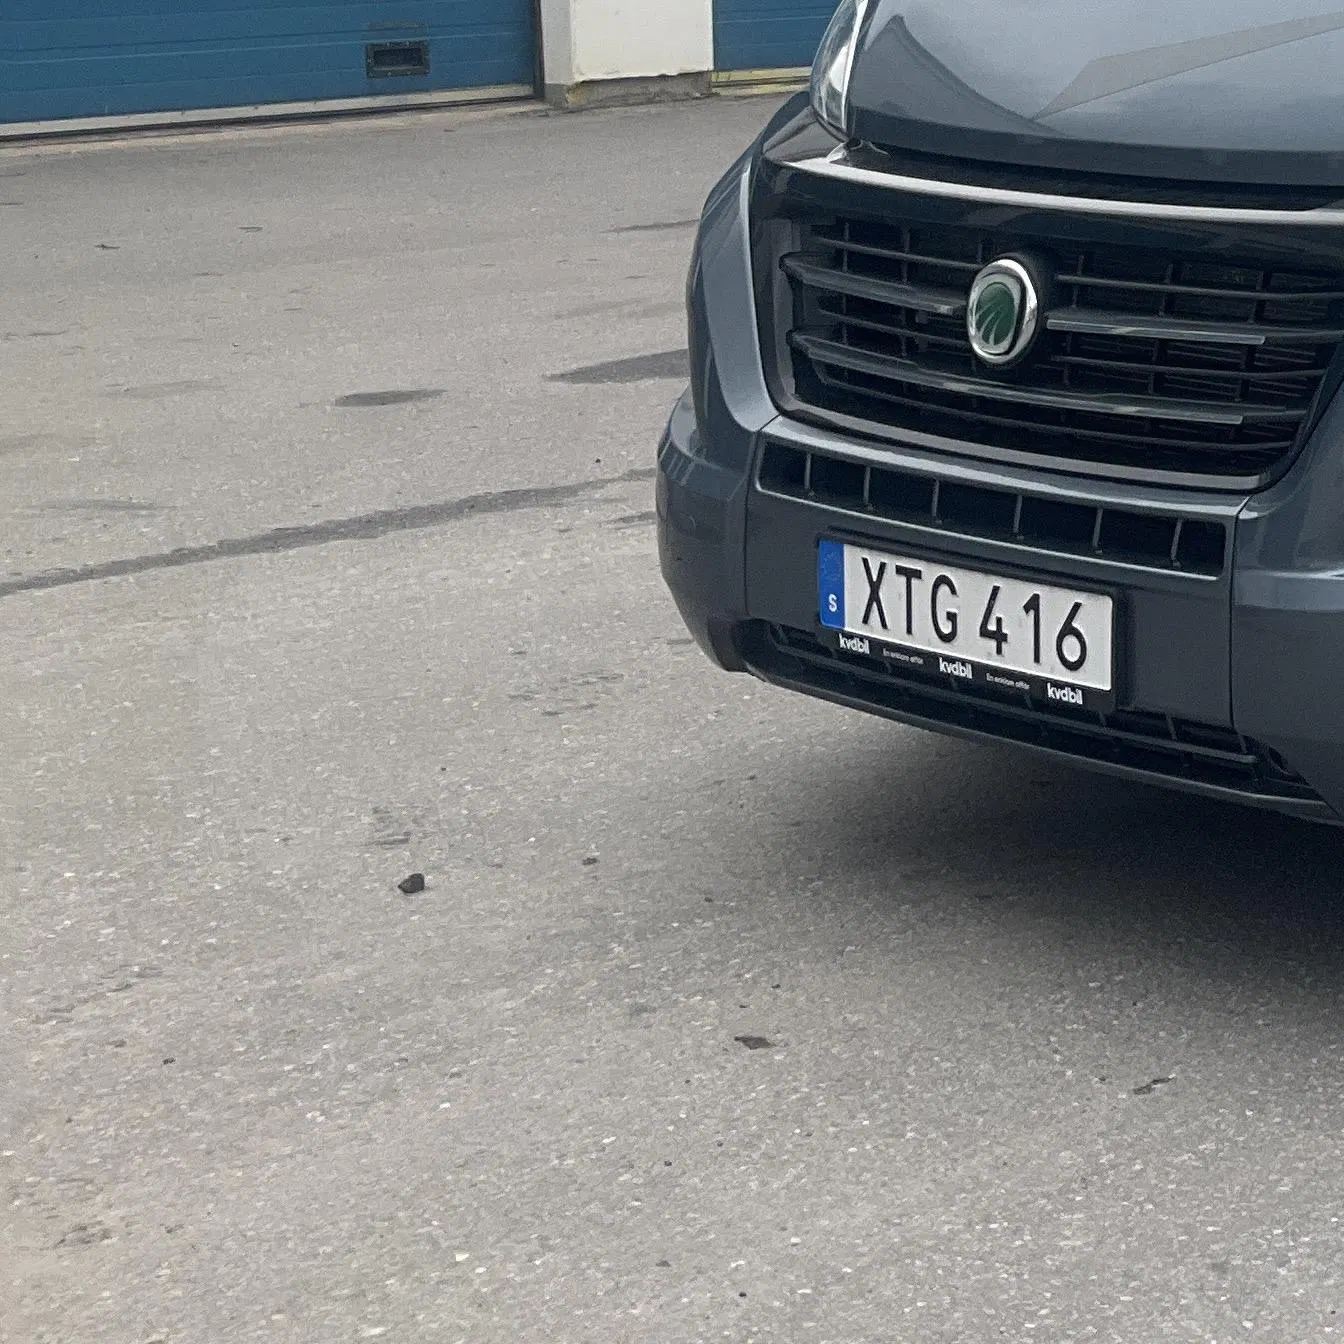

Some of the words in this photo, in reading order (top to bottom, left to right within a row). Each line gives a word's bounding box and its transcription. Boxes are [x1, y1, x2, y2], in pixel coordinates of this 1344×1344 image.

[828, 593, 838, 612] S
[861, 557, 958, 643] XTG
[979, 585, 1088, 671] 416
[939, 657, 973, 679] kvdbil
[1046, 682, 1083, 705] kvdbil
